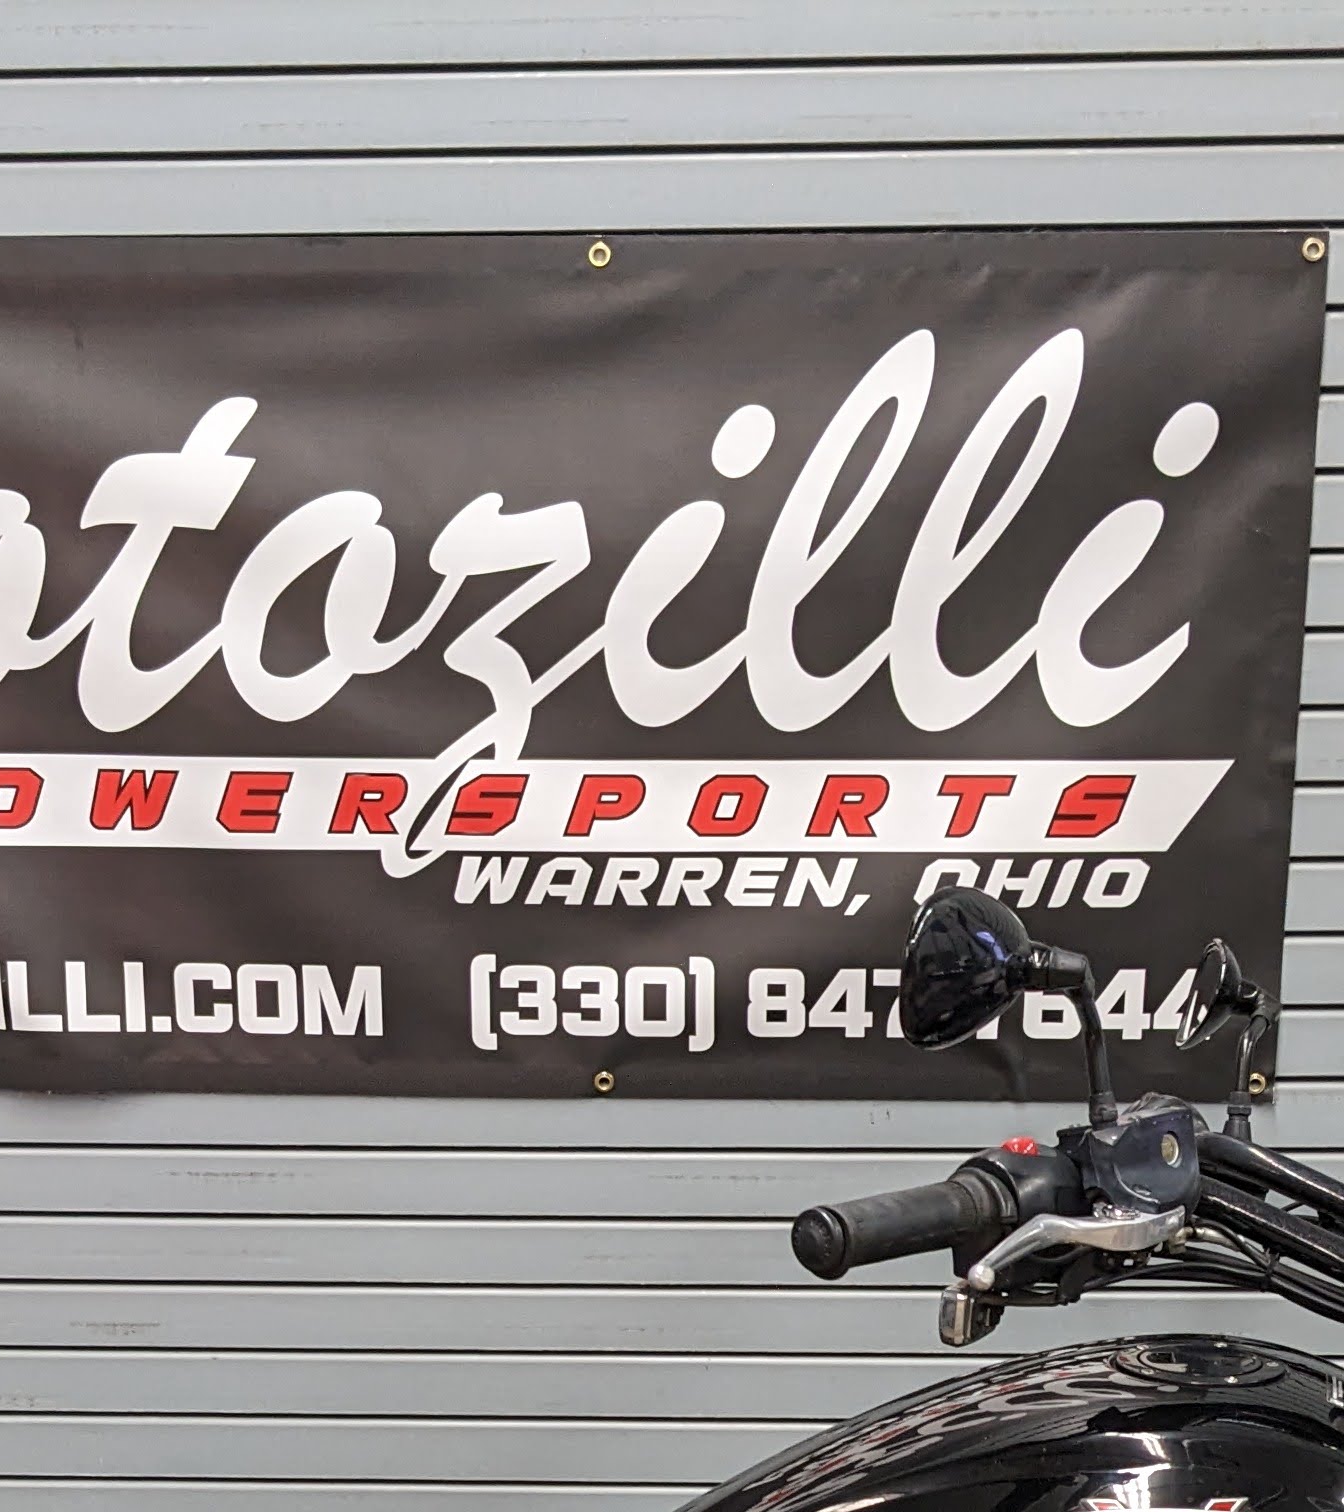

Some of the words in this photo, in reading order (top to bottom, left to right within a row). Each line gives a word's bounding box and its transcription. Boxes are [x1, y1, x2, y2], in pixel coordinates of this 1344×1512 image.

[454, 855, 871, 915] WARREN,
[914, 858, 1150, 909] OHIO
[470, 954, 715, 1052] (330)
